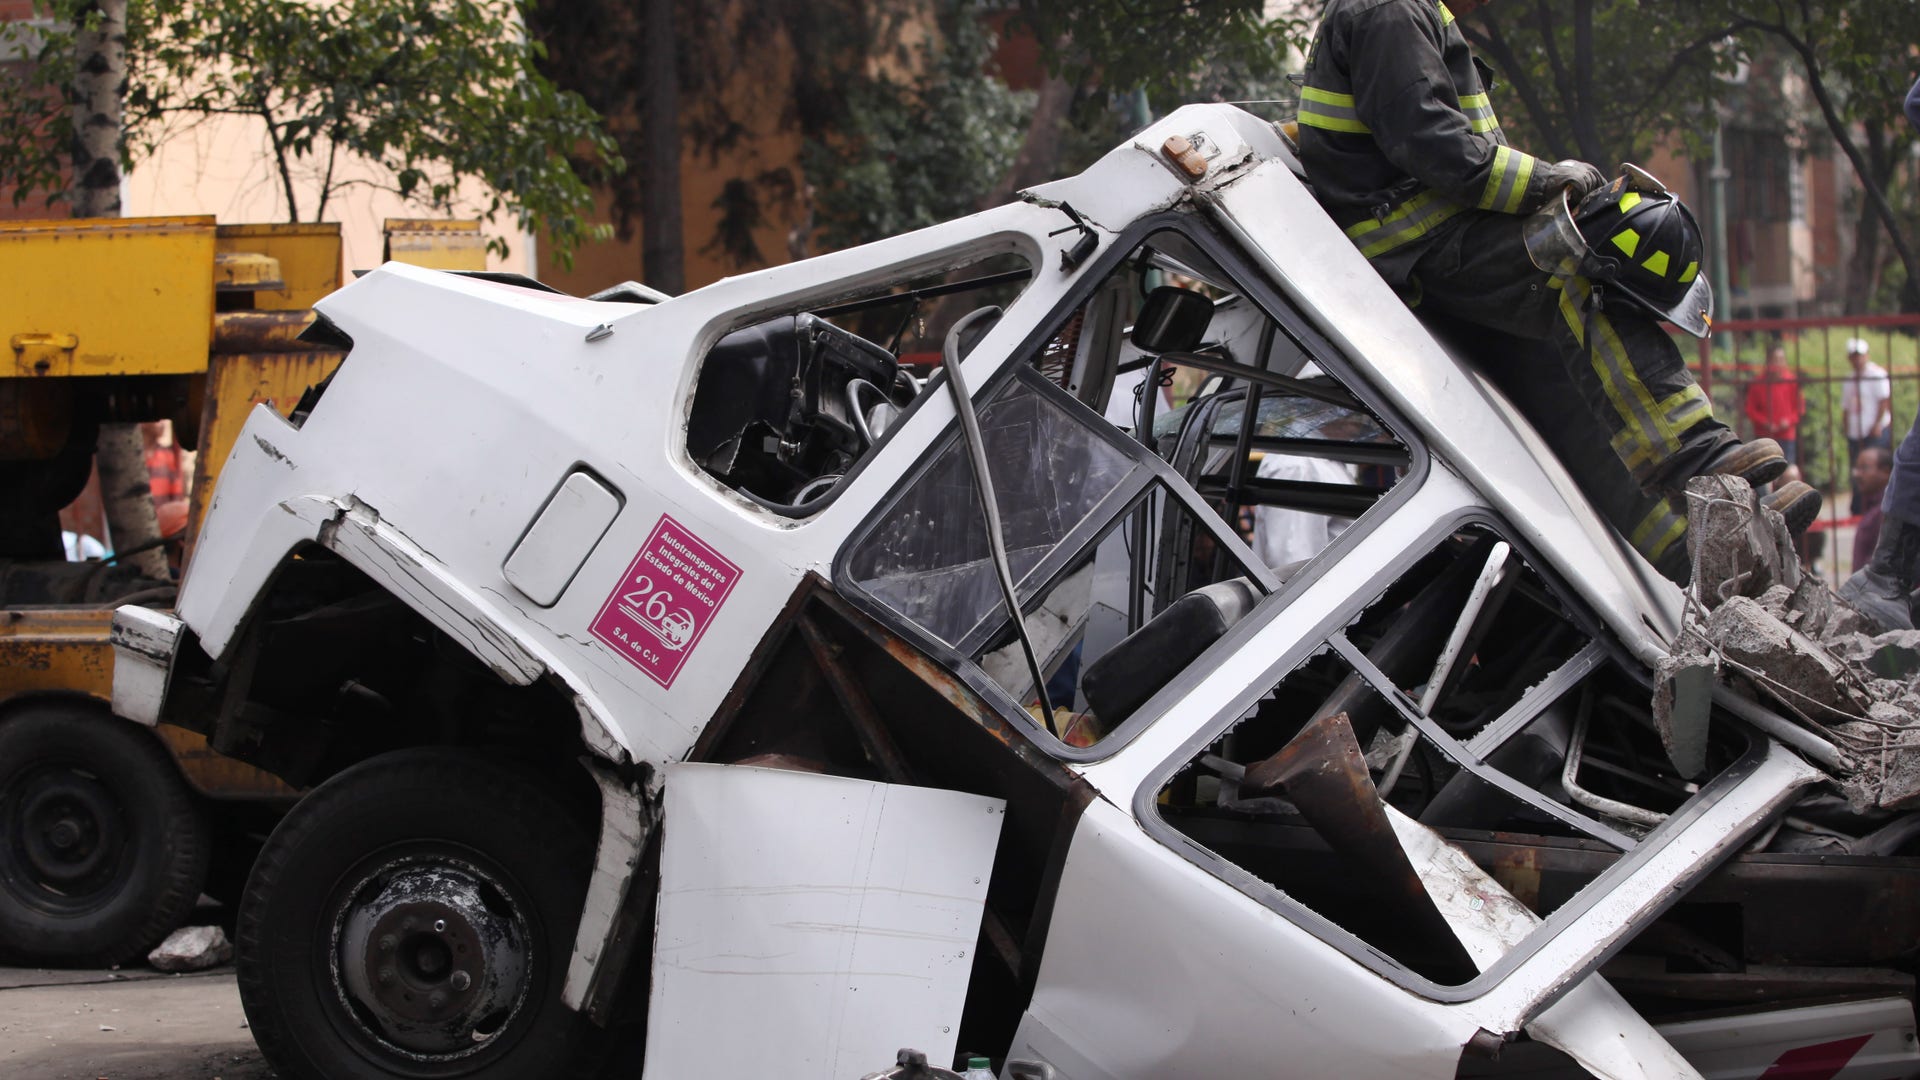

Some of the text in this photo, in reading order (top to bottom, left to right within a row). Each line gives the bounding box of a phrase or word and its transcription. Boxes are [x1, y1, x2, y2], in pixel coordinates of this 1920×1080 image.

[644, 551, 715, 608] Estado de México
[658, 545, 716, 591] Integrales del
[661, 531, 727, 584] Autotransportes
[612, 626, 660, 666] S.A. de C.V.
